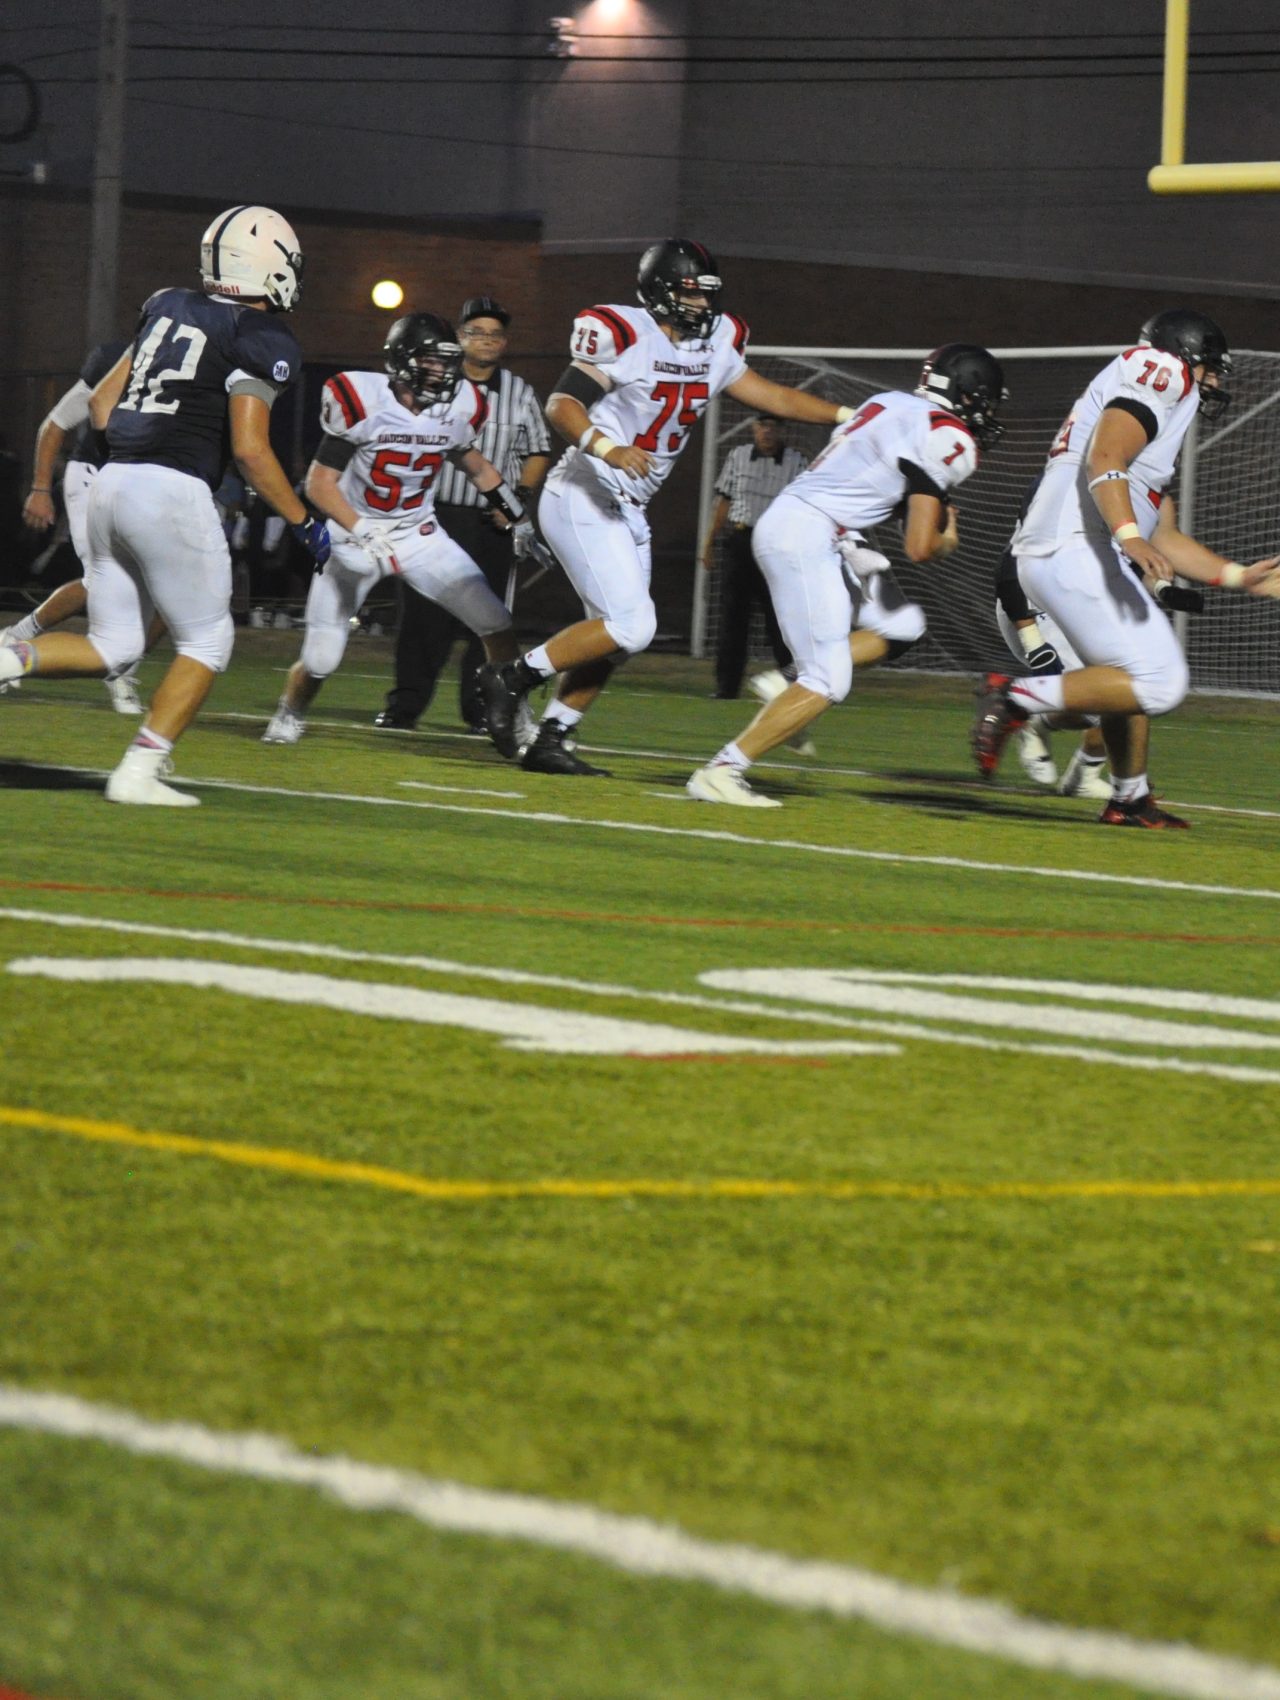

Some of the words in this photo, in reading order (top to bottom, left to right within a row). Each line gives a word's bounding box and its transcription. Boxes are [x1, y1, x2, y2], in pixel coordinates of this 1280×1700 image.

[575, 327, 599, 355] 75
[117, 316, 208, 415] 12
[1136, 359, 1172, 392] 76
[633, 381, 709, 453] 75
[943, 441, 966, 466] 7
